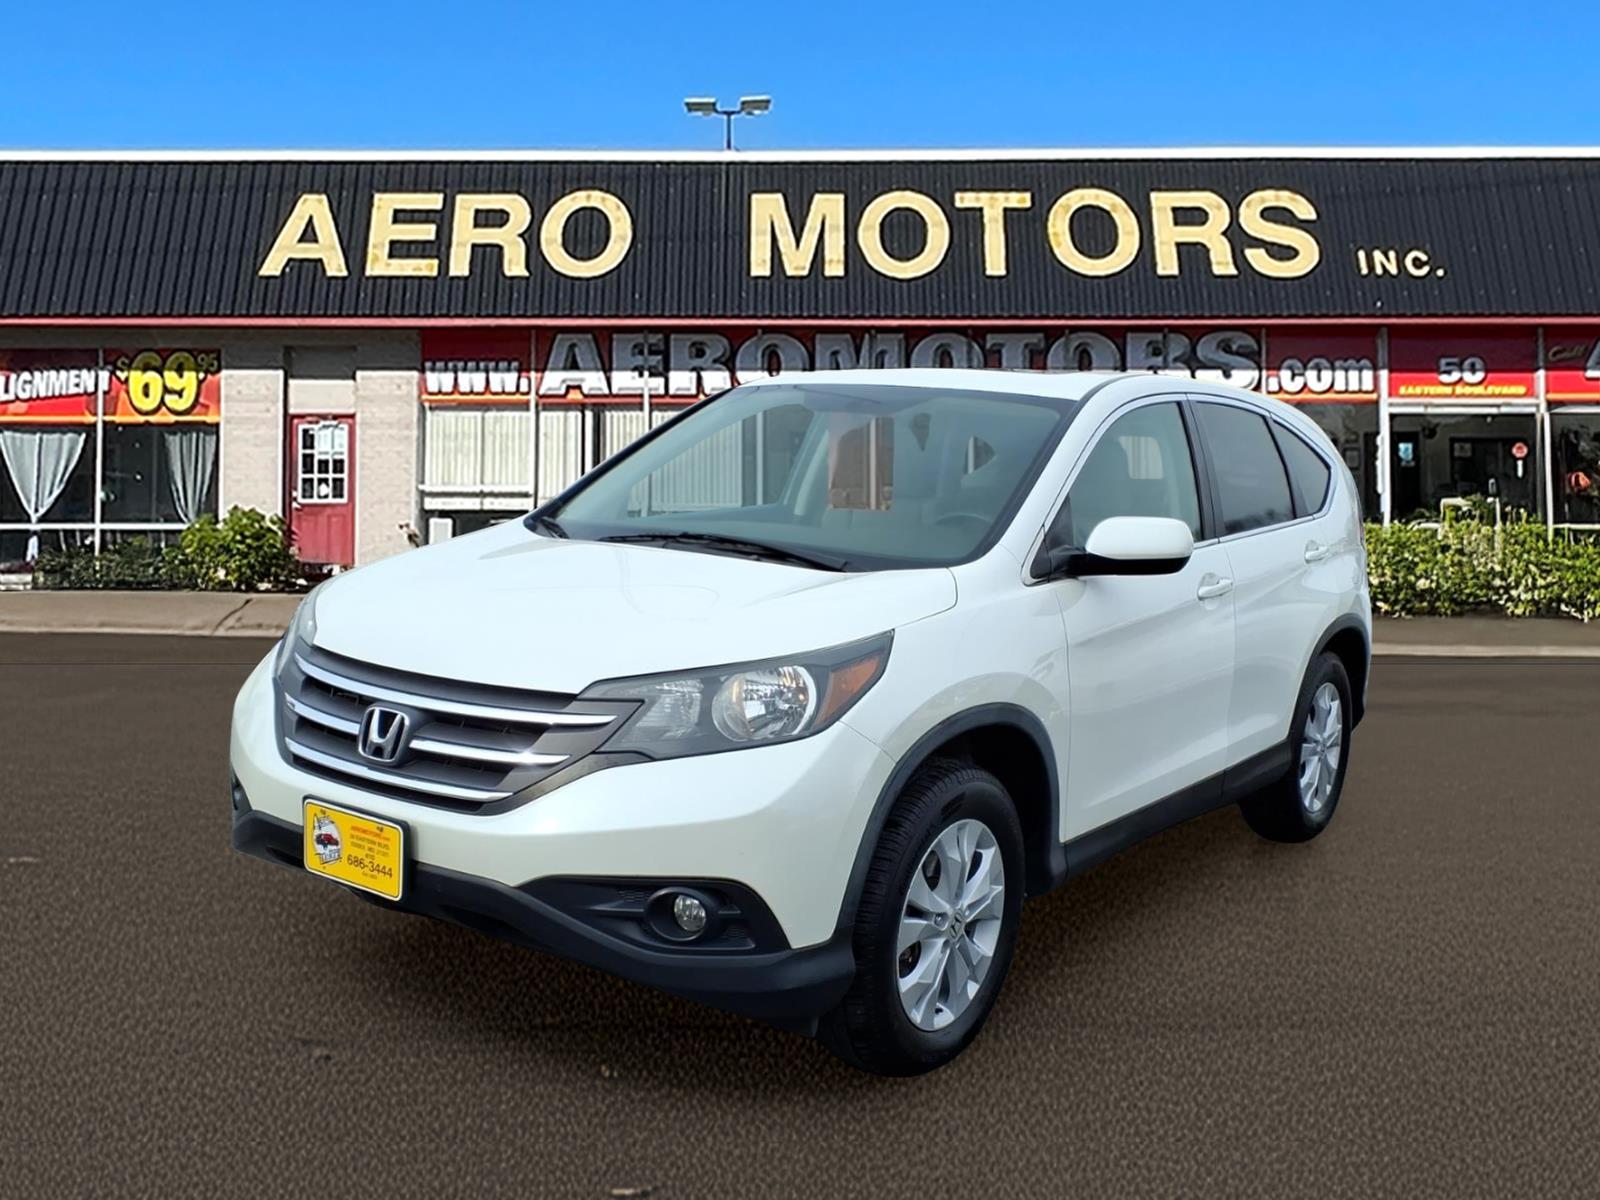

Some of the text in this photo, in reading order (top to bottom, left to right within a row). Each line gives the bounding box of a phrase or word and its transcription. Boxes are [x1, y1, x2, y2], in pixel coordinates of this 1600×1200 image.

[259, 188, 1446, 280] AERO MOTORS INC.
[1438, 356, 1486, 385] 50
[1399, 385, 1454, 396] EASTERN
[347, 853, 393, 879] 686-3444
